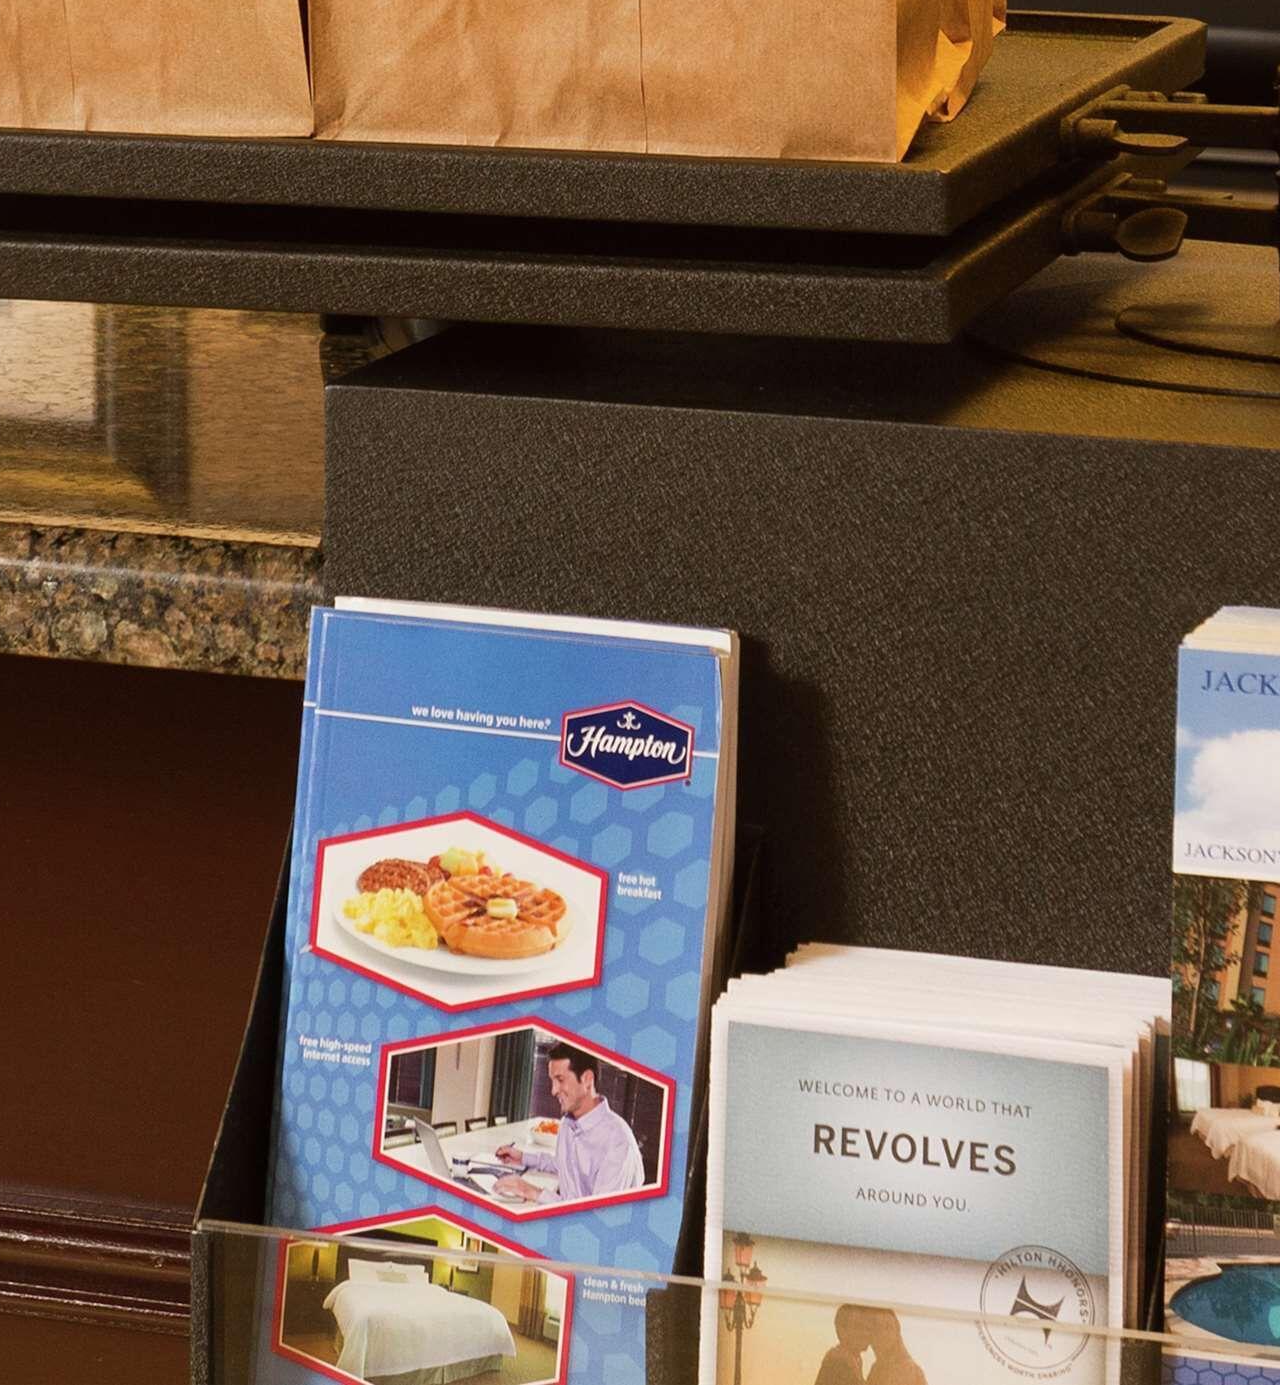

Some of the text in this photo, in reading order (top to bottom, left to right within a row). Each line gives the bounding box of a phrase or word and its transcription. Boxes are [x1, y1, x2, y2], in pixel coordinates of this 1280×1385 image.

[411, 704, 429, 717] we
[431, 705, 455, 721] love
[456, 707, 494, 727] having
[495, 716, 518, 729] you
[567, 724, 687, 765] Hampton
[618, 871, 656, 888] free hot
[617, 885, 662, 901] breakfast
[319, 1037, 372, 1054] high-speed
[798, 1078, 1033, 1119] WELCOME TO A WORLD THAT
[812, 1122, 1018, 1177] REVOLVES
[855, 1187, 928, 1208] AROUND
[583, 1276, 609, 1288] clean
[620, 1280, 644, 1293] fresh
[997, 1252, 1090, 1319] HILTON HHONORS
[583, 1289, 627, 1304] Hampton
